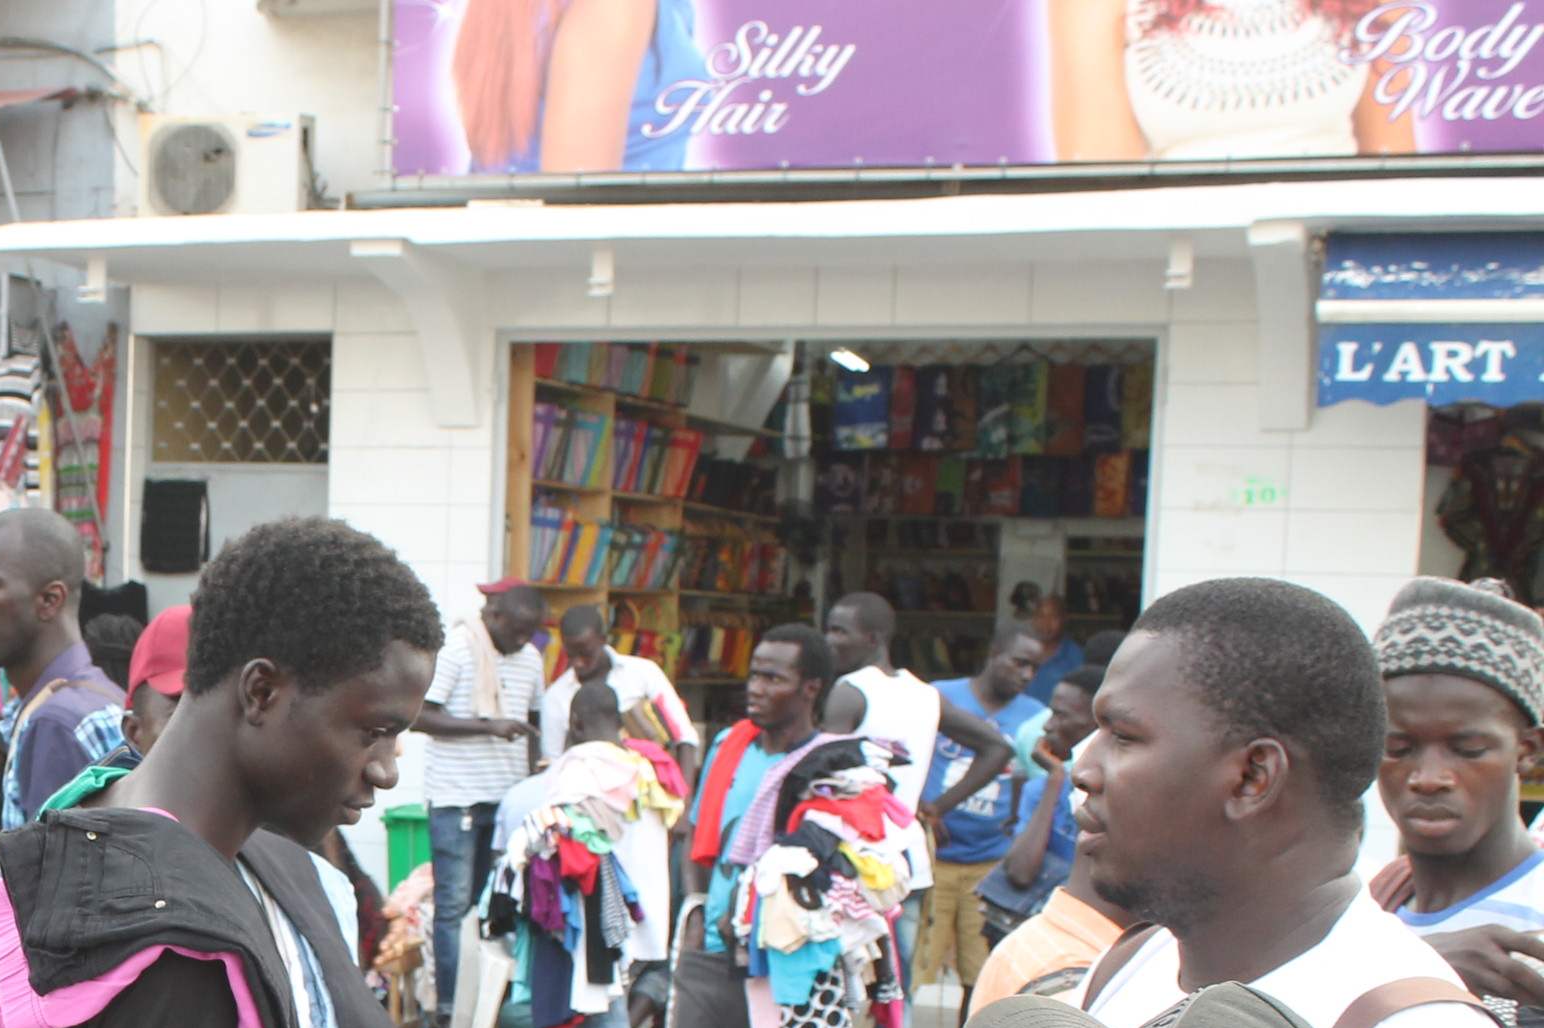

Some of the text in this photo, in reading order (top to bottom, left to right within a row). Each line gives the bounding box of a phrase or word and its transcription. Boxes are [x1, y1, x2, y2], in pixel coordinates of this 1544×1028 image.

[704, 19, 857, 96] Silky
[1338, 1, 1544, 80] Body
[640, 75, 791, 138] Hair
[1373, 59, 1544, 122] Wave
[1334, 339, 1517, 382] L'ART
